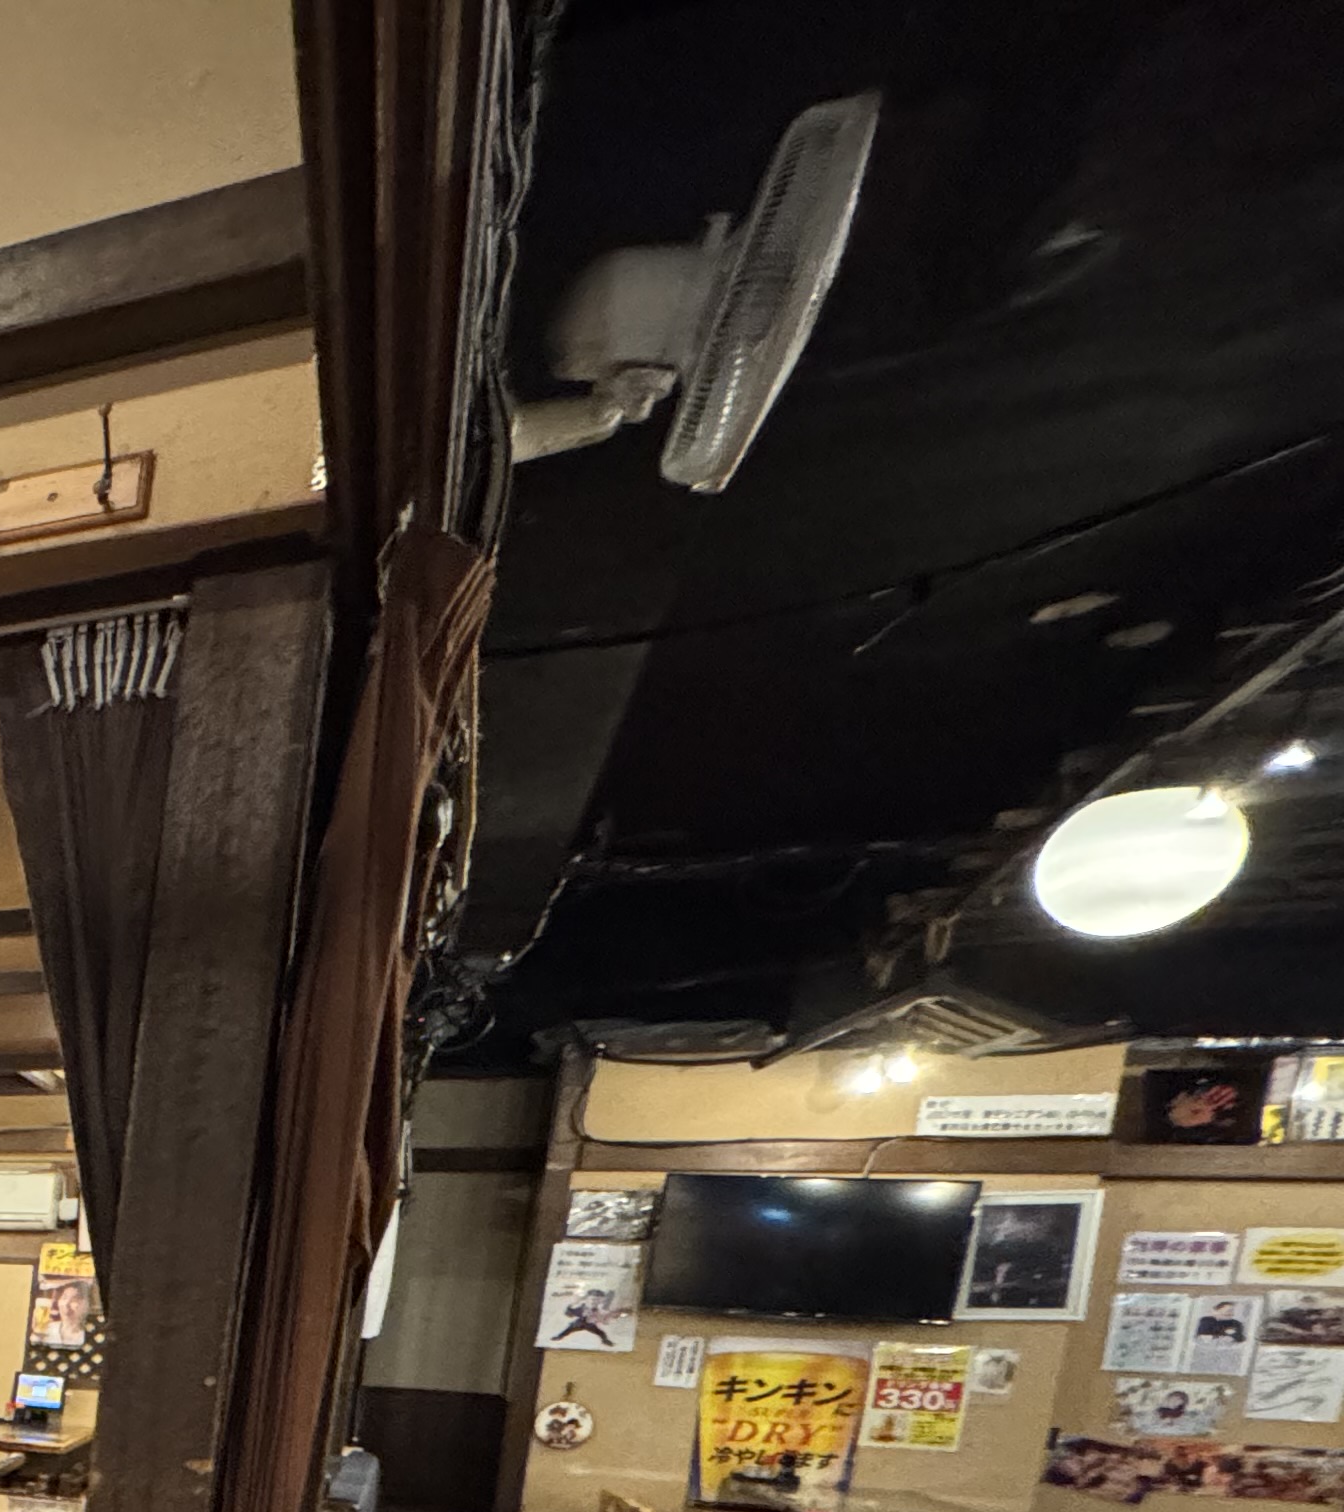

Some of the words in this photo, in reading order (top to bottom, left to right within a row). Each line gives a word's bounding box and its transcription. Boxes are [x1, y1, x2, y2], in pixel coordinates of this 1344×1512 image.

[708, 1447, 839, 1469] 冷やします
